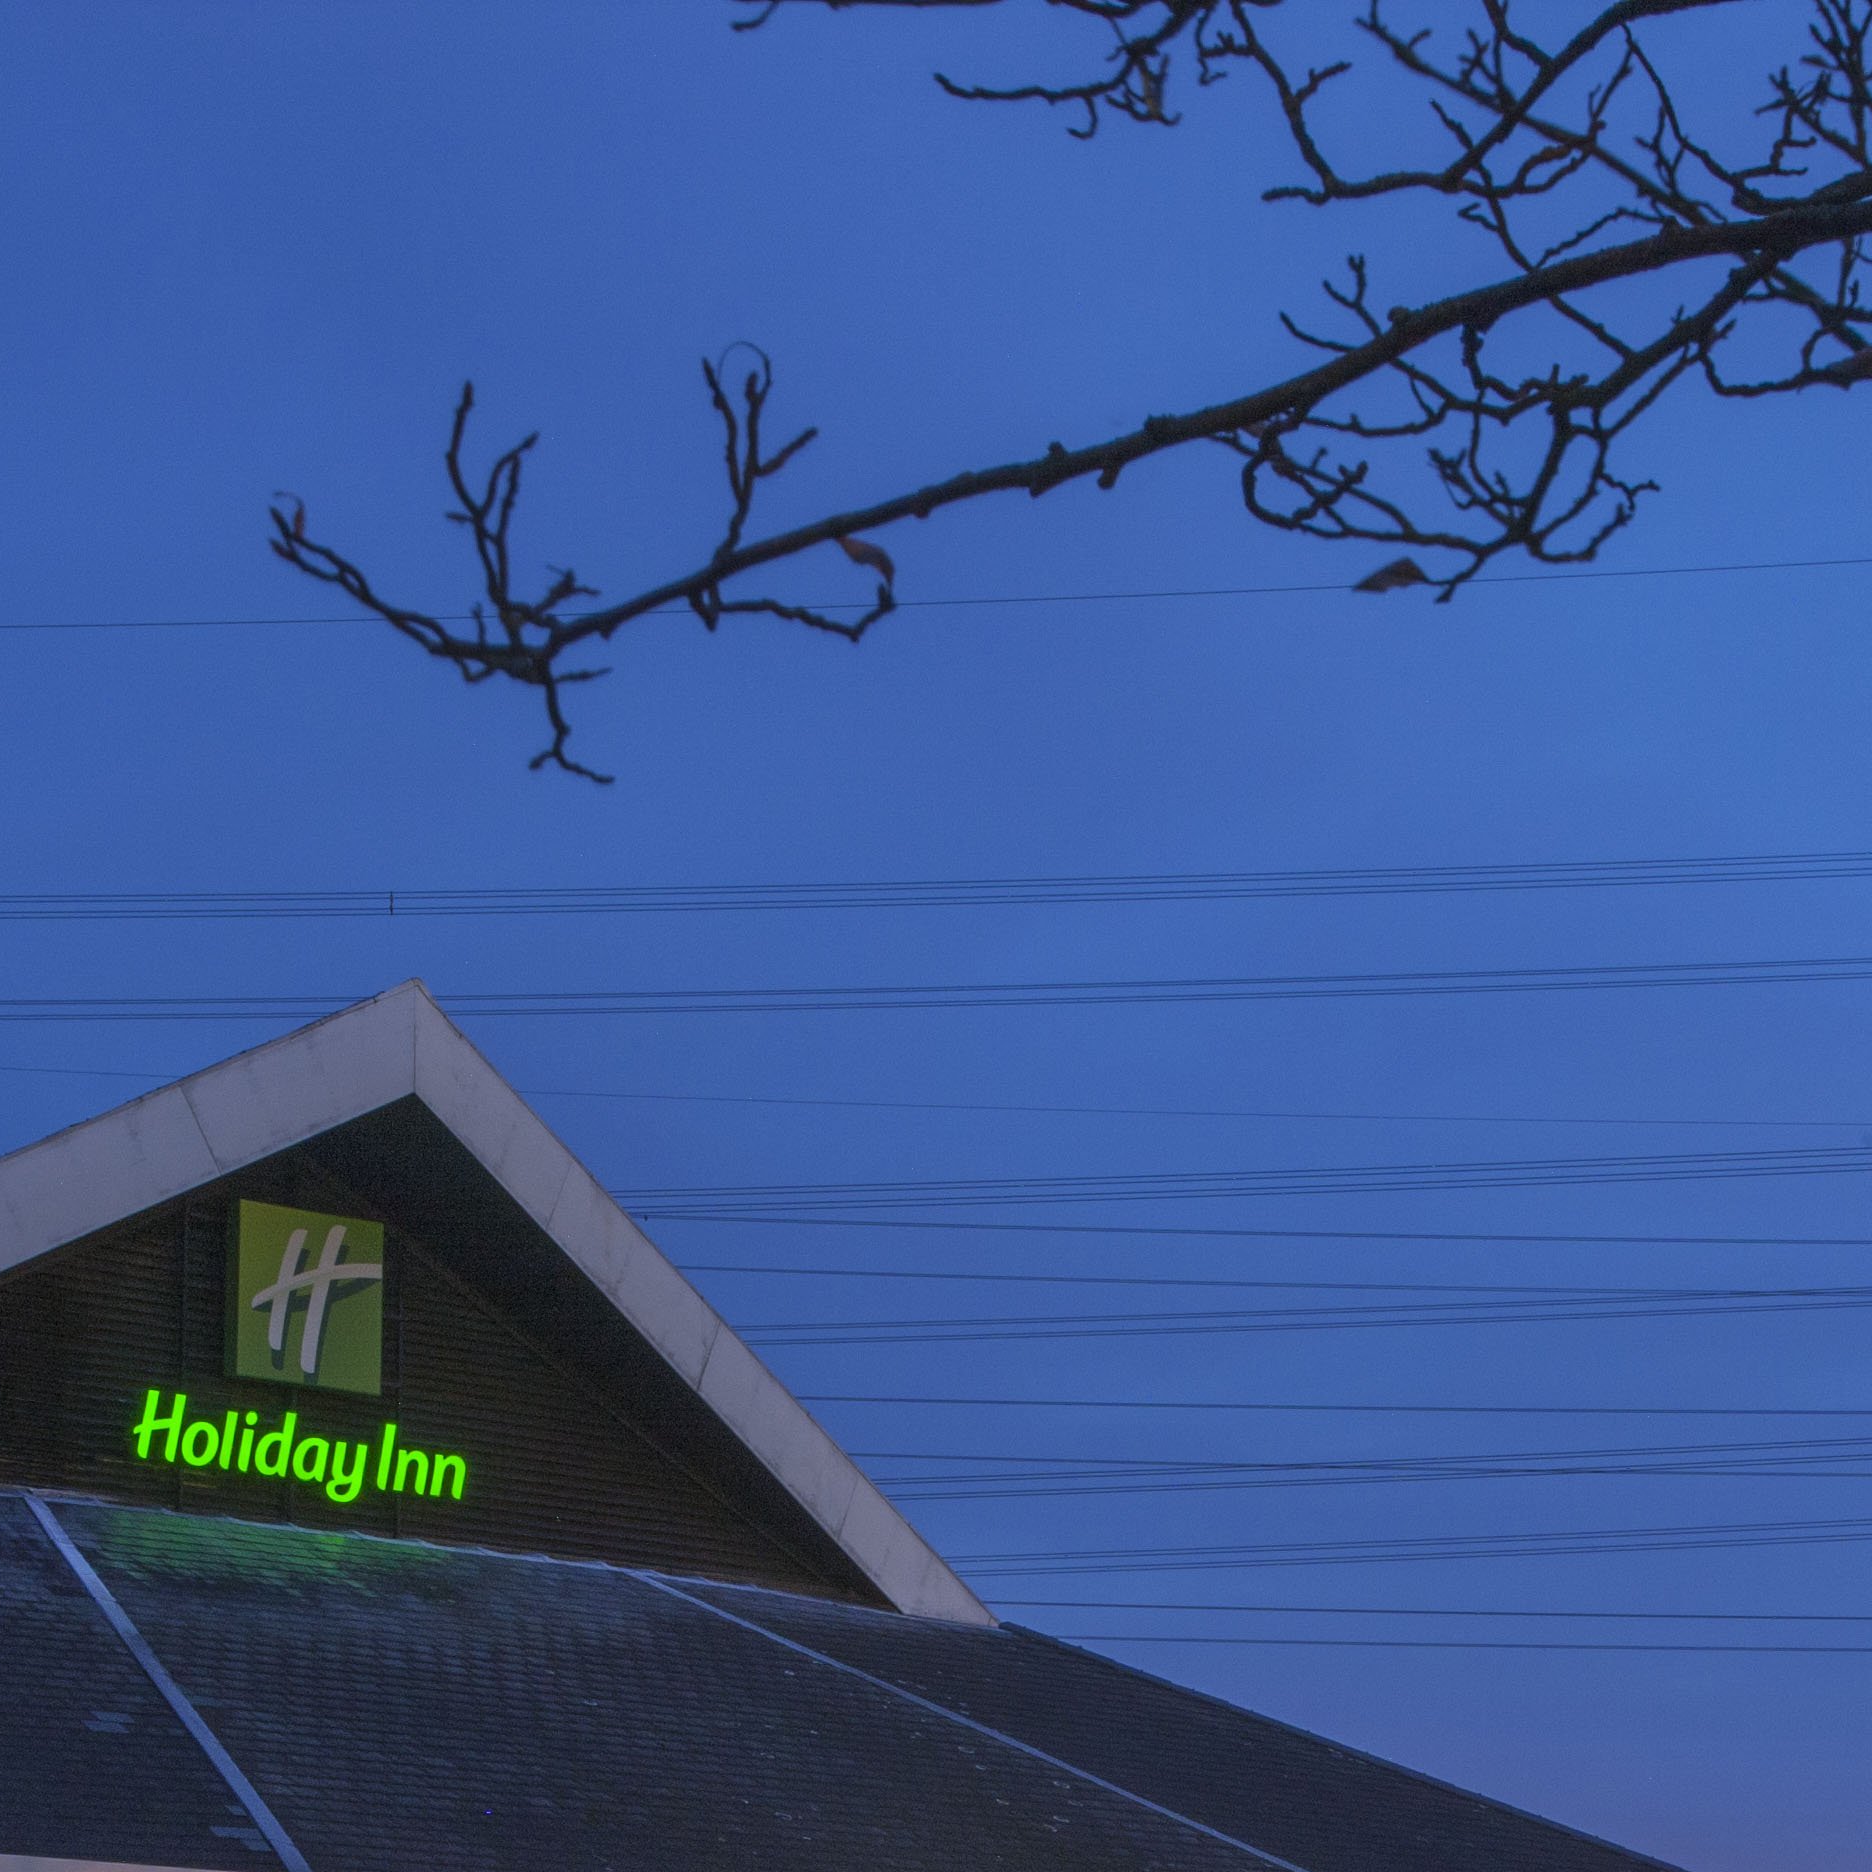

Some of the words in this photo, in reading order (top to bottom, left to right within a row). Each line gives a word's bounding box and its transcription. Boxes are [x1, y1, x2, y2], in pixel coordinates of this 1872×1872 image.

[251, 1225, 383, 1374] H
[133, 1390, 368, 1502] Holiday
[376, 1423, 467, 1500] Inn
